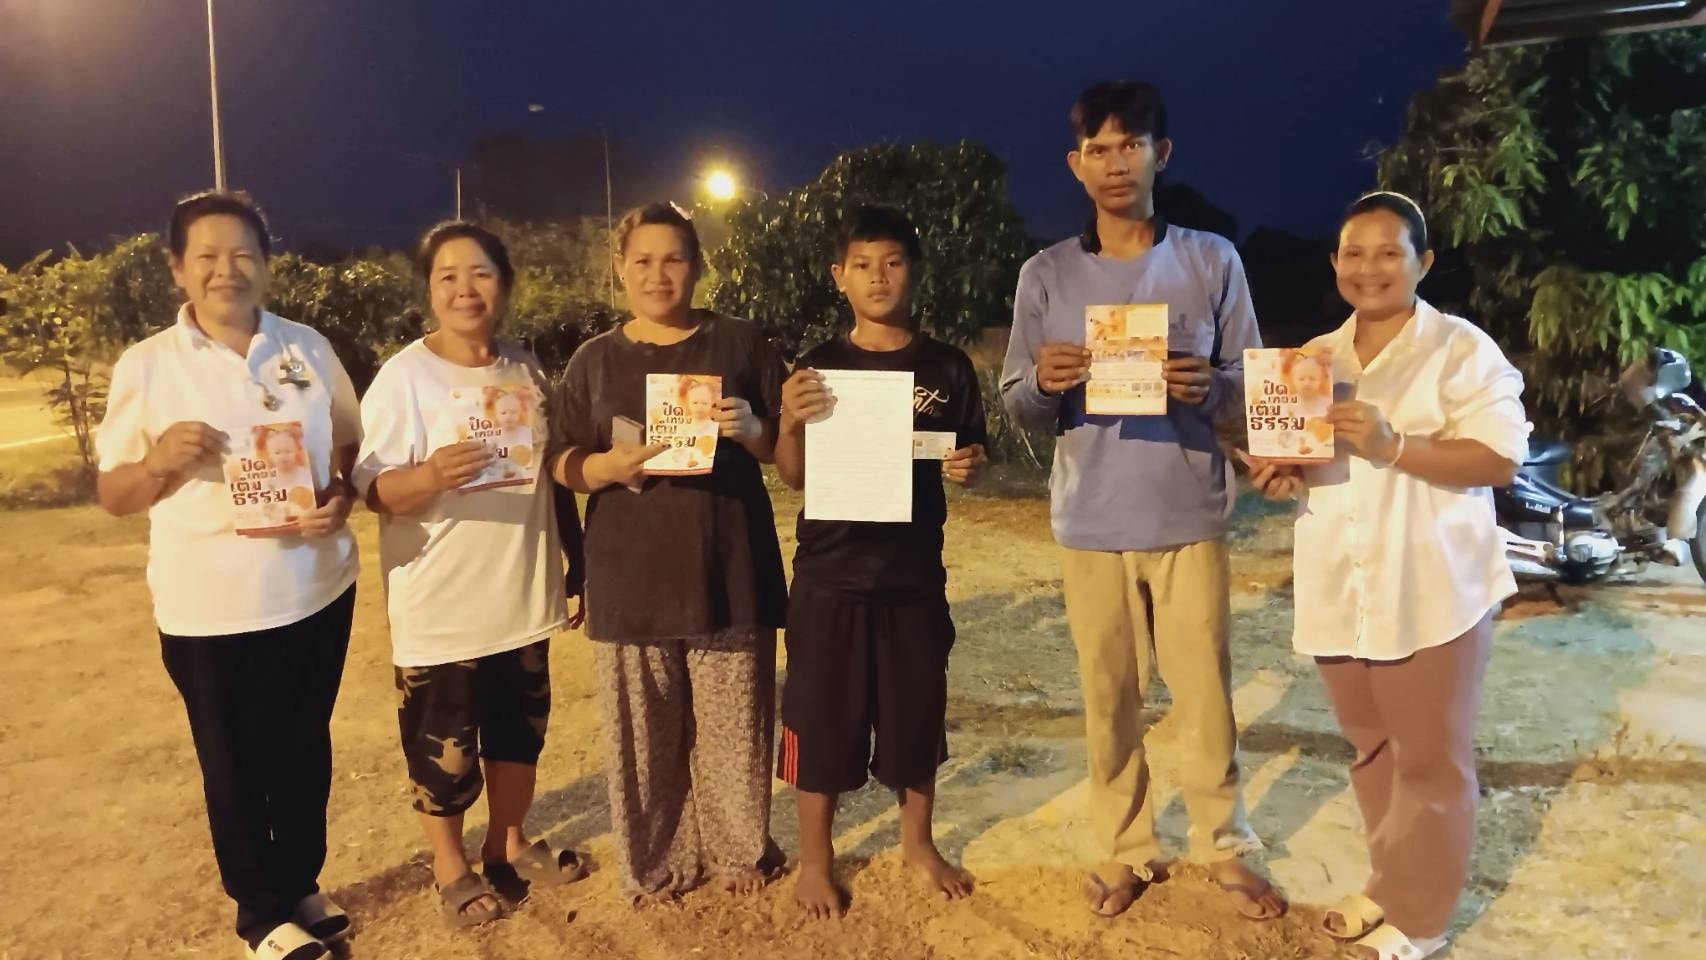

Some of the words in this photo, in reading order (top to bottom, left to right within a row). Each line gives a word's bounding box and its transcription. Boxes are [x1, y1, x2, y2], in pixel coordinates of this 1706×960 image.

[1263, 379, 1288, 396] ปิด
[662, 401, 684, 416] ปิด
[469, 416, 492, 431] ปิด
[1250, 416, 1305, 431] ธรรม
[240, 457, 266, 473] ปิด
[232, 488, 288, 506] ธรรม
